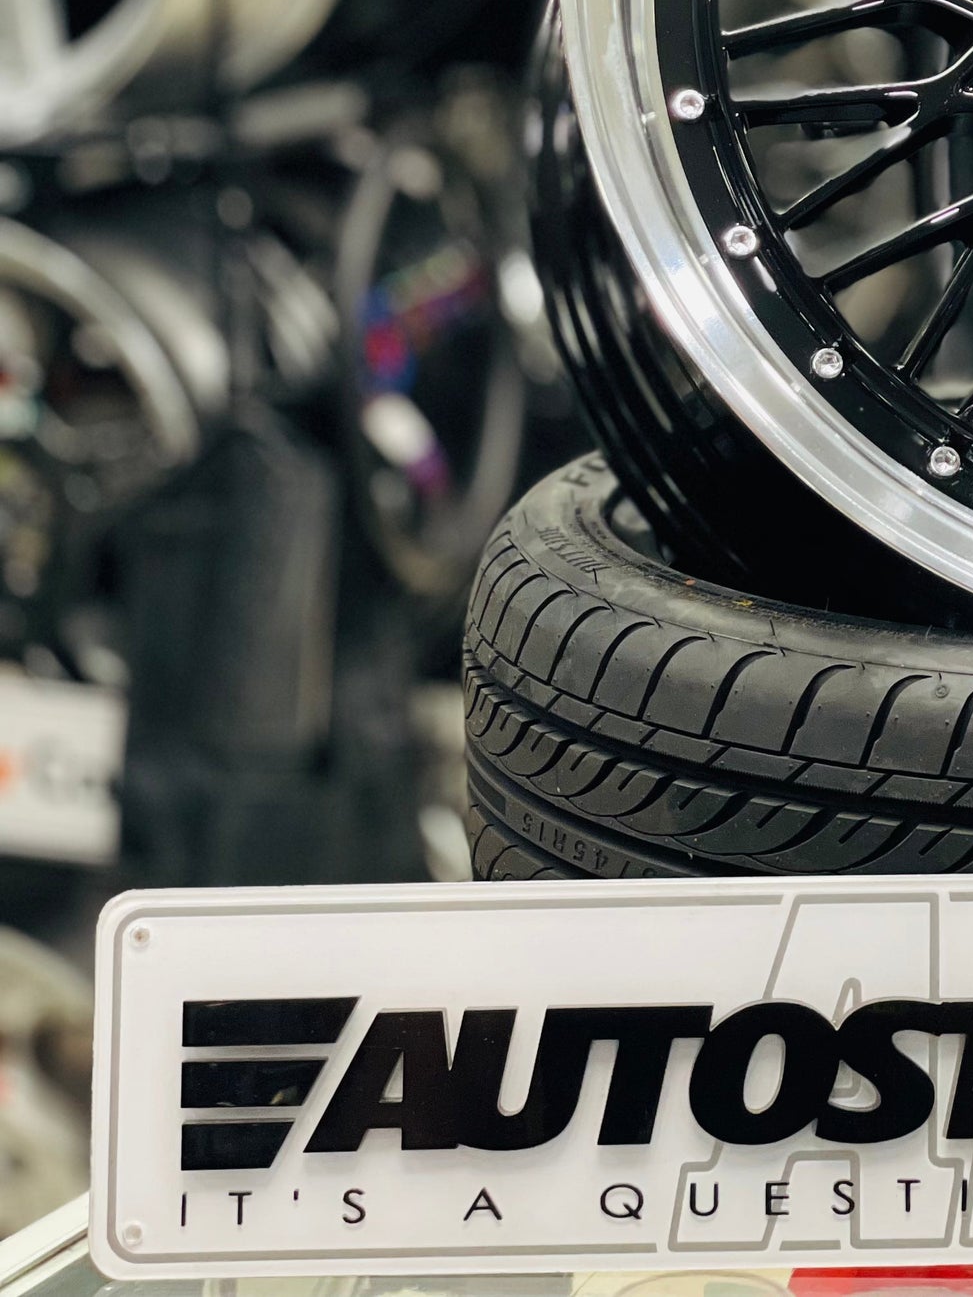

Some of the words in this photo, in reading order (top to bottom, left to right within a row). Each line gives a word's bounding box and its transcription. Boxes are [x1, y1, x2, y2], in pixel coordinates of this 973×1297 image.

[534, 525, 613, 574] OUTSIDE
[180, 1188, 367, 1227] IT'S
[463, 1187, 503, 1221] A
